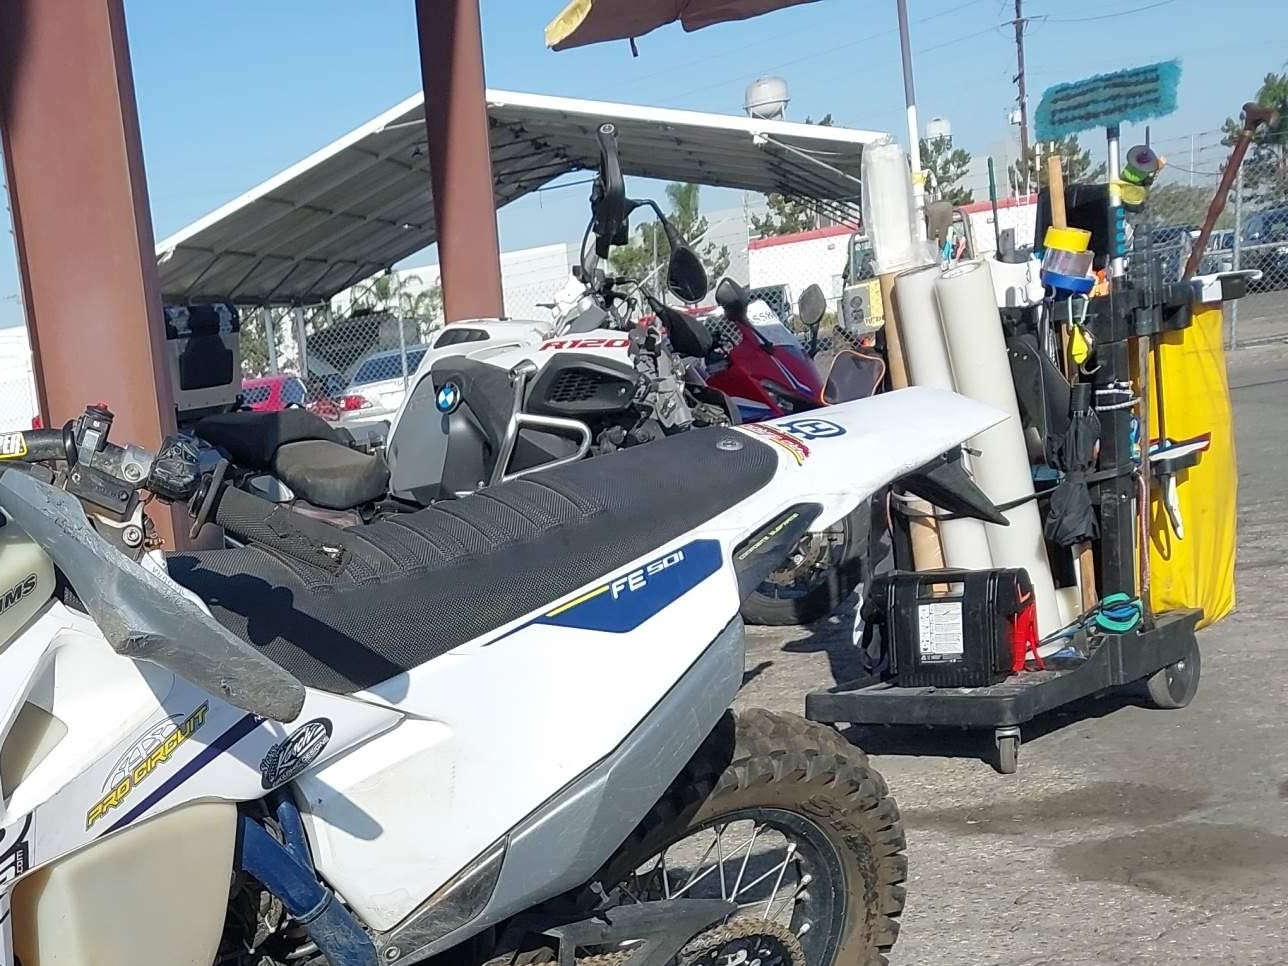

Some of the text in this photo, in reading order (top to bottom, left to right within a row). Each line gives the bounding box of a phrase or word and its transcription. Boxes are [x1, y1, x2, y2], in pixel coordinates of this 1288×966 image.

[612, 550, 685, 600] FE 501
[86, 775, 132, 829] PRO
[132, 701, 209, 786] CIRCUIT
